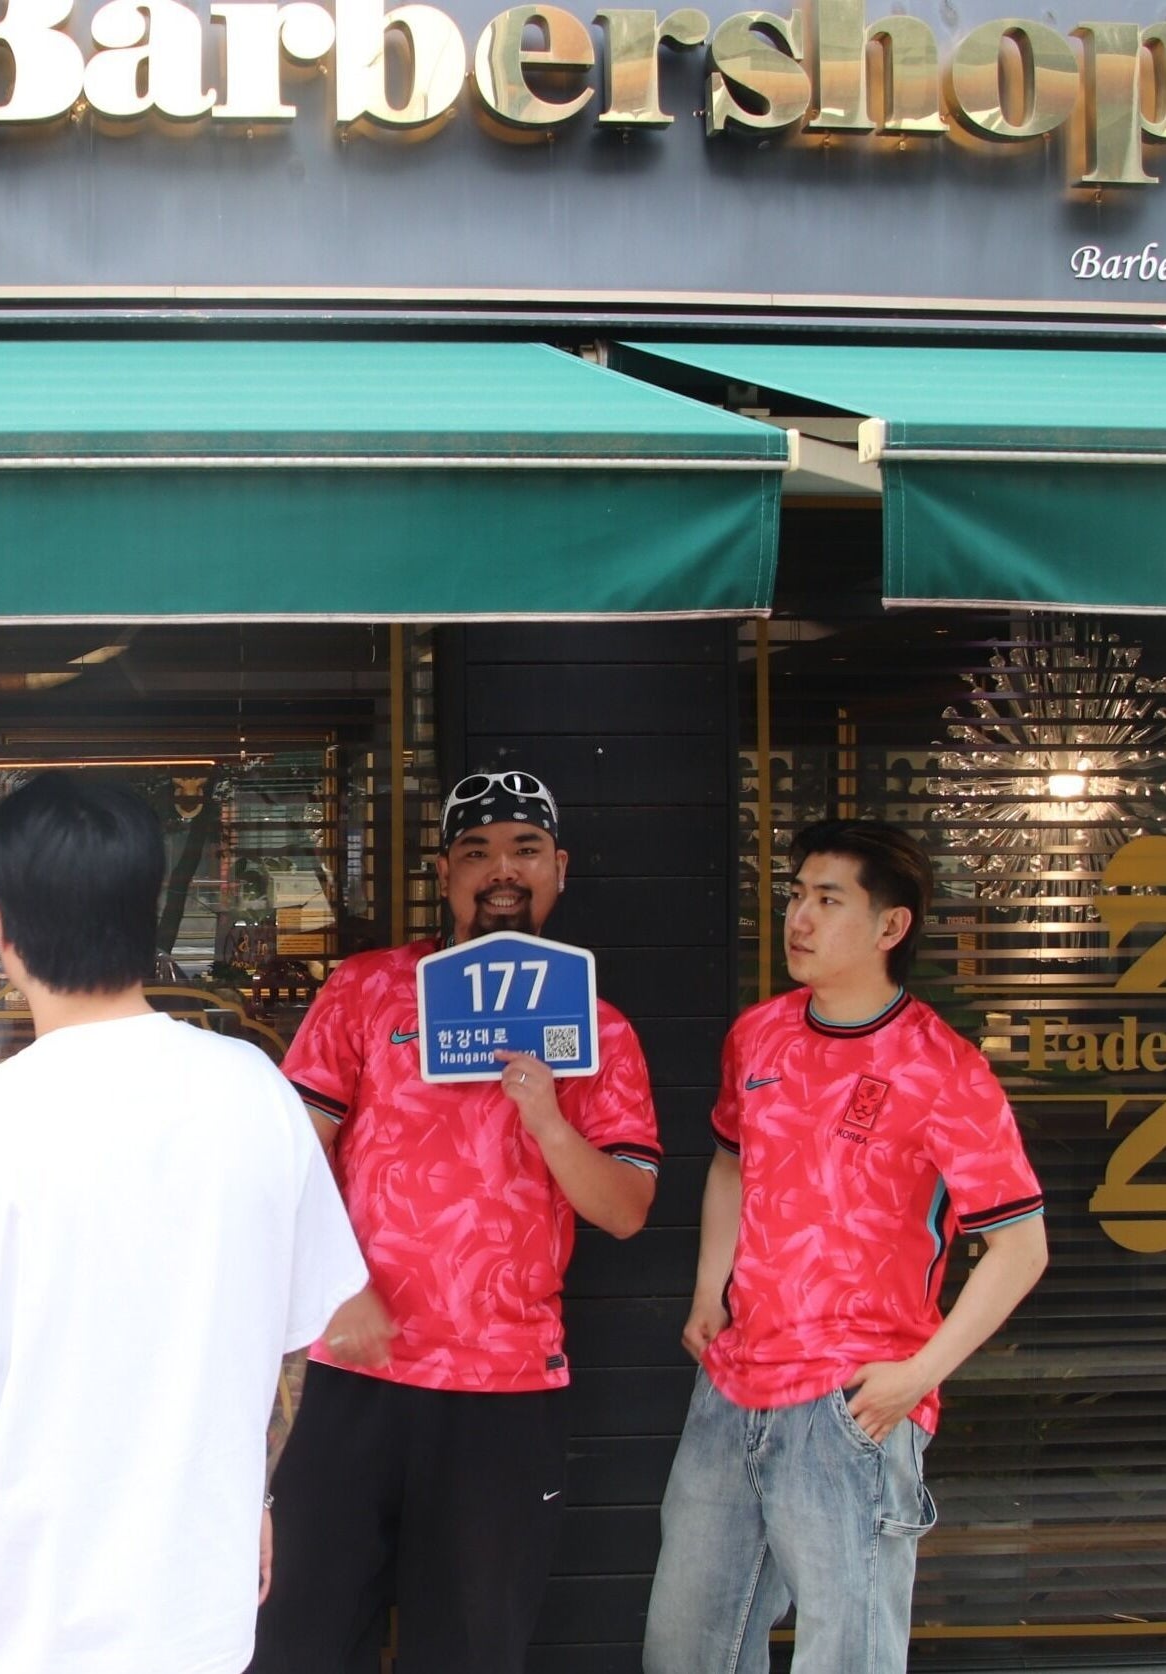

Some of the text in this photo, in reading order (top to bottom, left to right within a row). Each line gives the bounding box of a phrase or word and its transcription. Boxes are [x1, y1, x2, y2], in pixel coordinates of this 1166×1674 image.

[463, 960, 548, 1013] 177
[437, 1027, 509, 1049] 한강대로
[835, 1127, 868, 1146] KOREA
